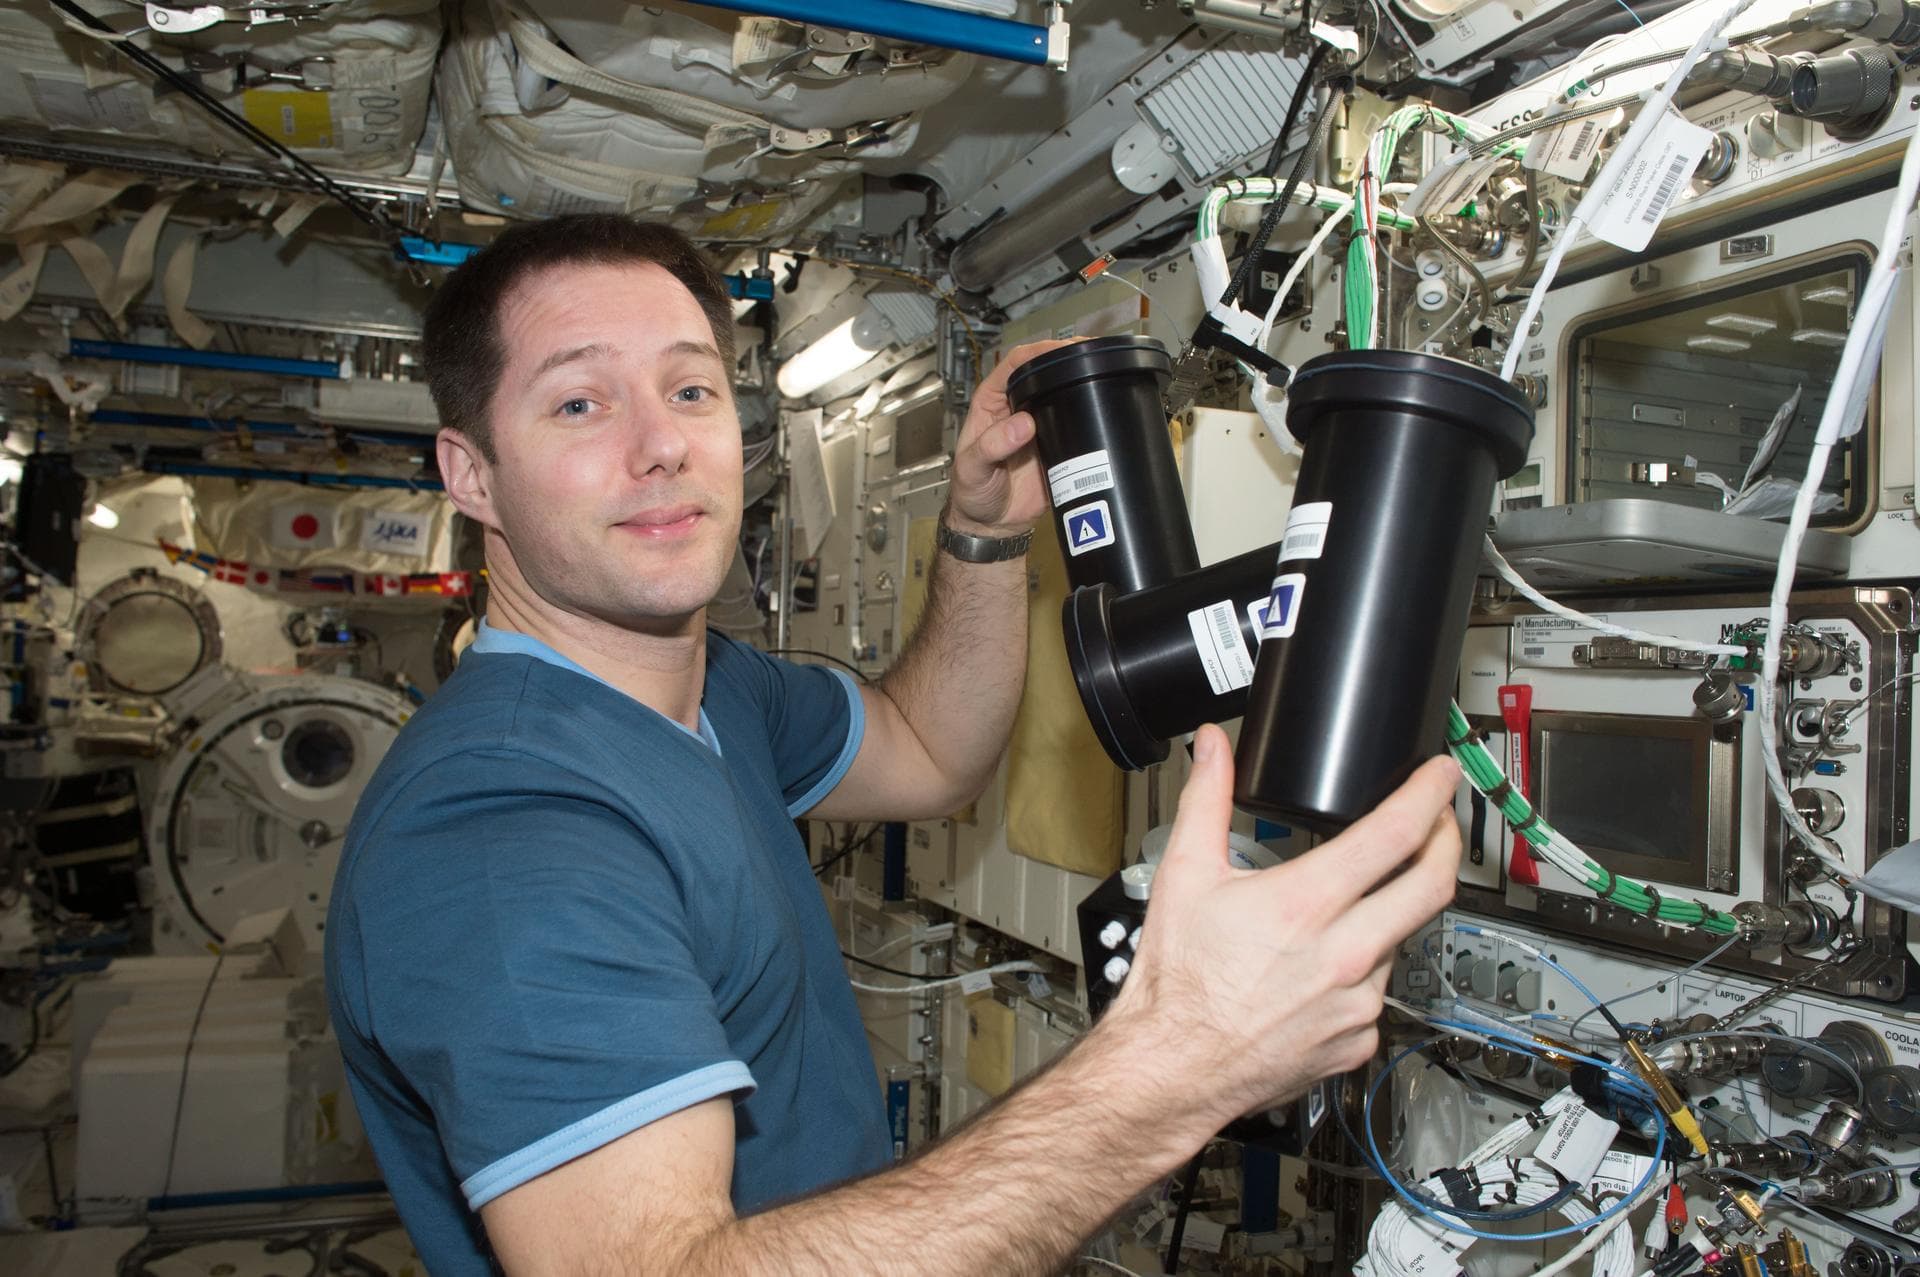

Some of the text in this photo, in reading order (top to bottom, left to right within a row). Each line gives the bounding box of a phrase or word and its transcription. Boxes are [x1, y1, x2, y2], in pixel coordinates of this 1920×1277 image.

[1888, 512, 1904, 520] LOCK
[1524, 618, 1575, 630] Manufacturing
[1715, 989, 1746, 1002] LAPTOP
